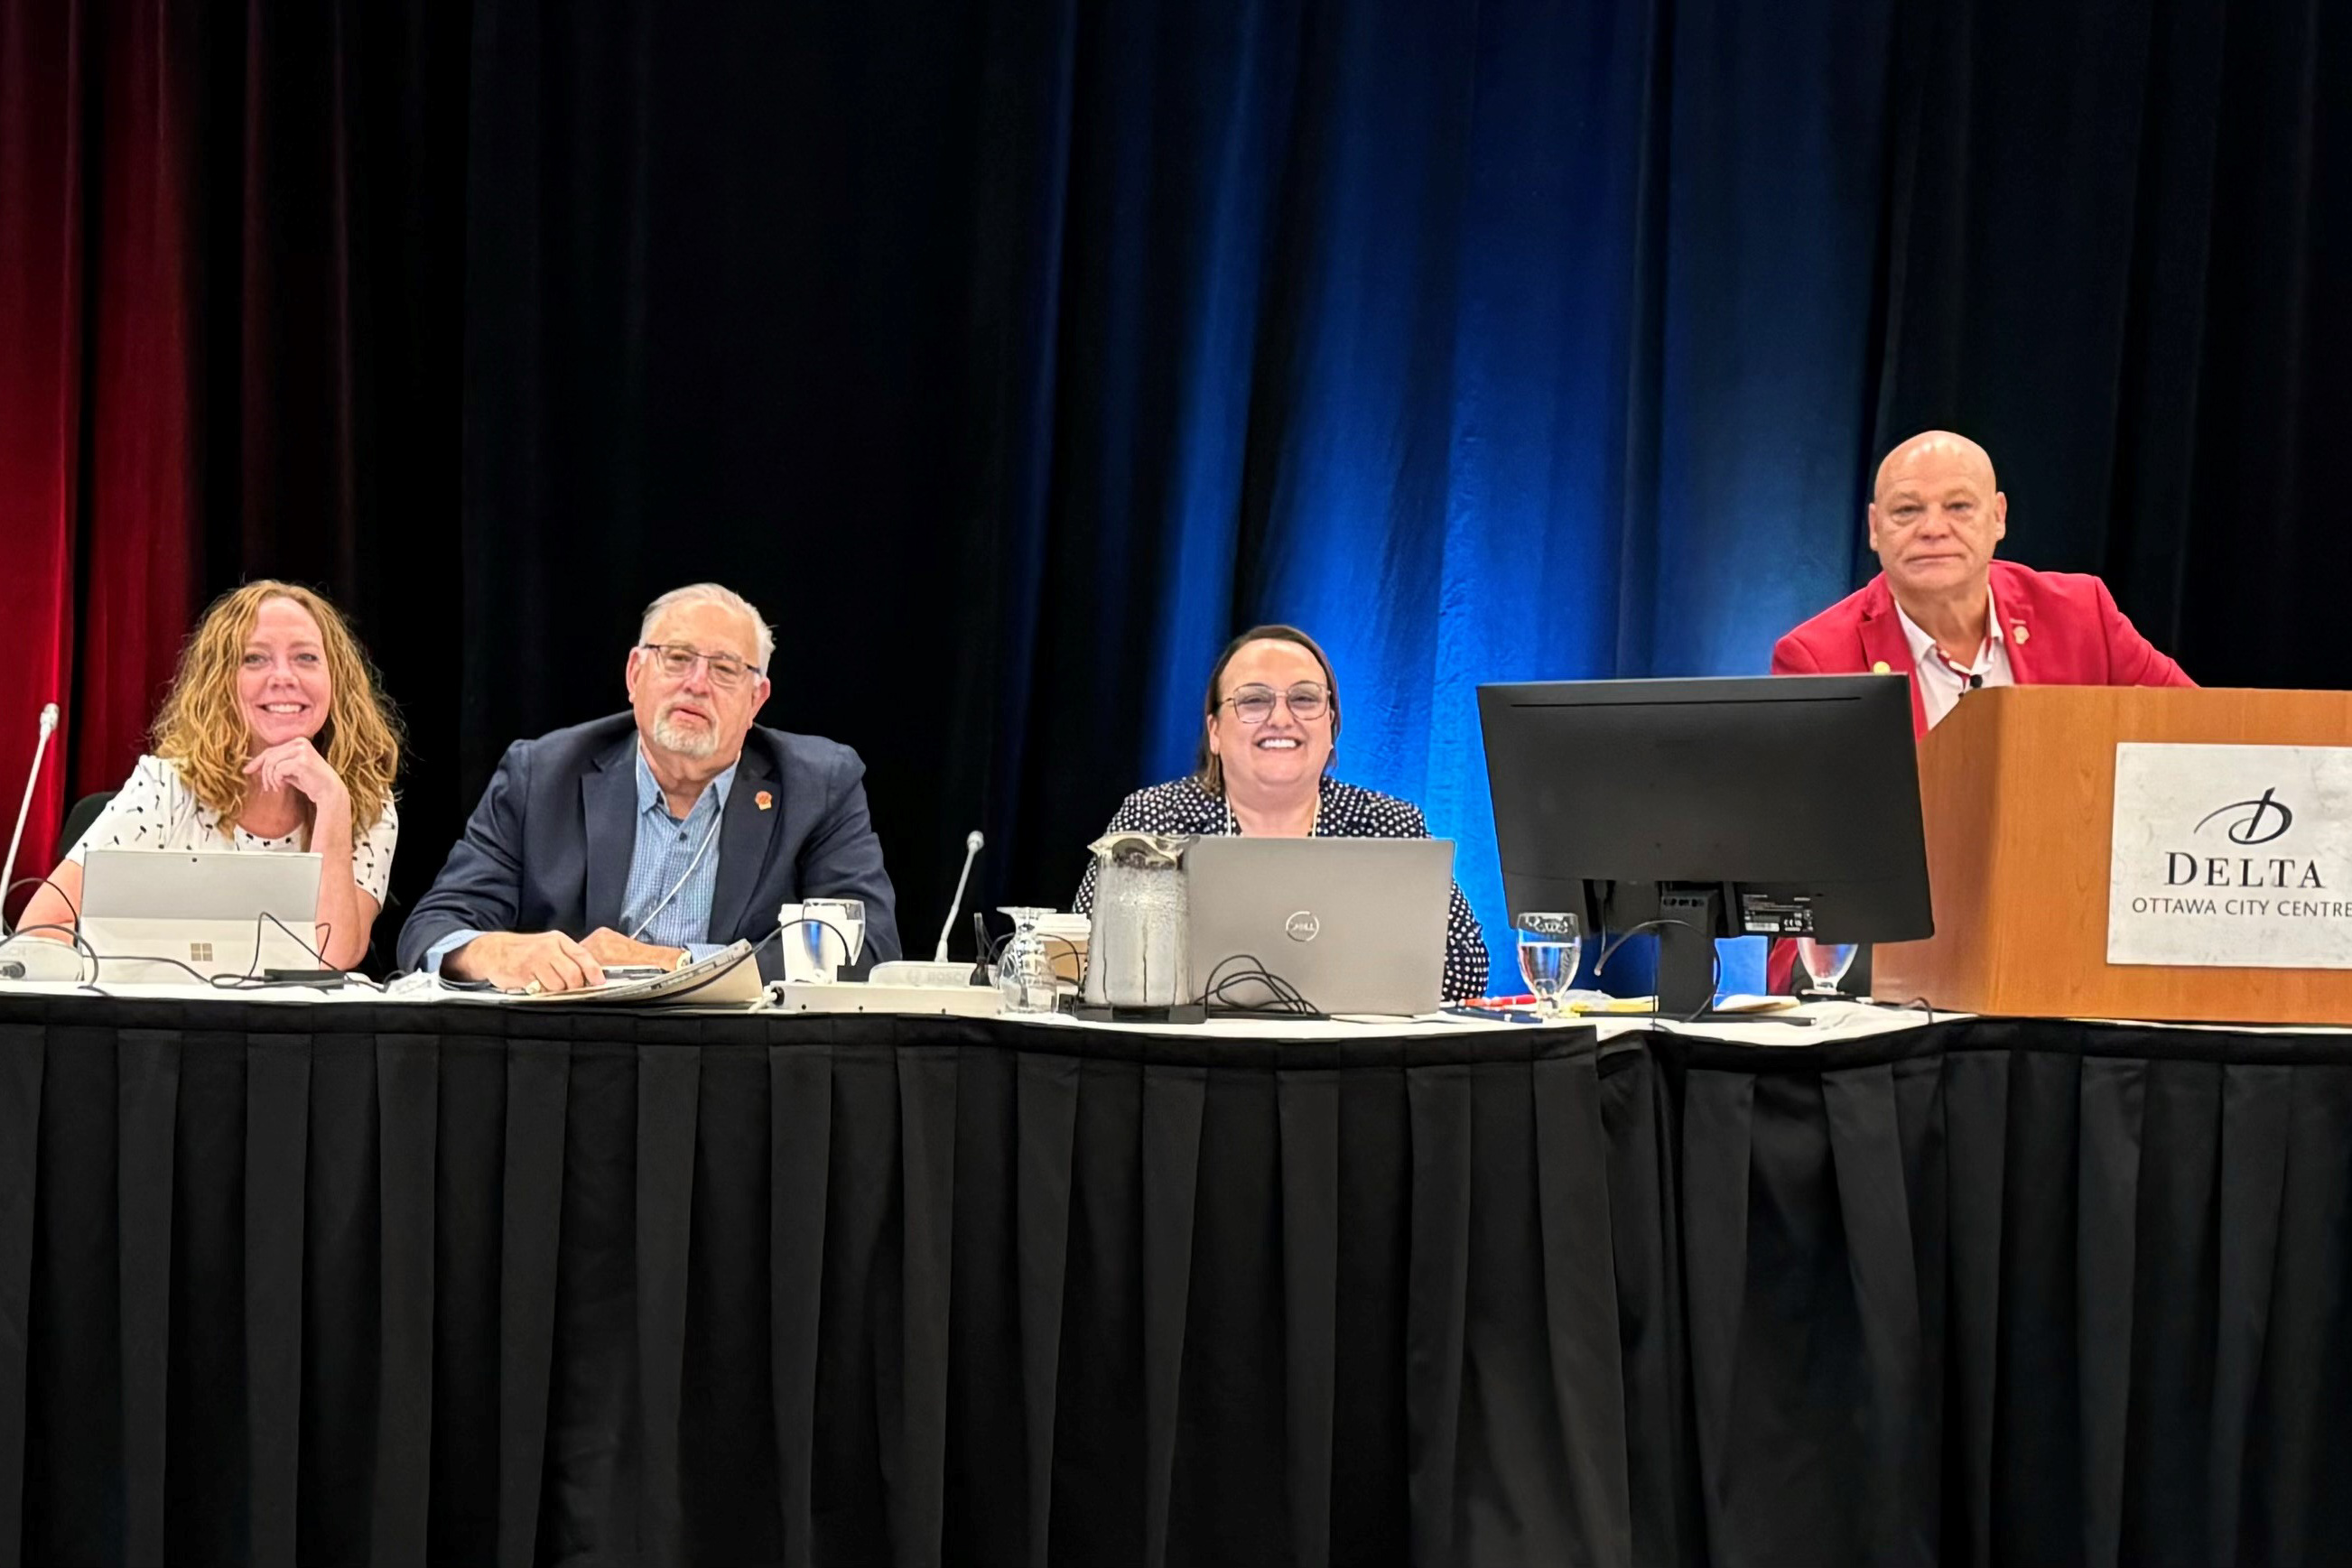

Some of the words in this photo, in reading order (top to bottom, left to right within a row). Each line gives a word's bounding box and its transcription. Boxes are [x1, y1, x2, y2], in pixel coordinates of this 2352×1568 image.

[2163, 851, 2327, 889] DELTA
[2132, 896, 2217, 915] OTTAWA
[2225, 899, 2271, 916] CITY
[2277, 900, 2352, 918] CENTRE
